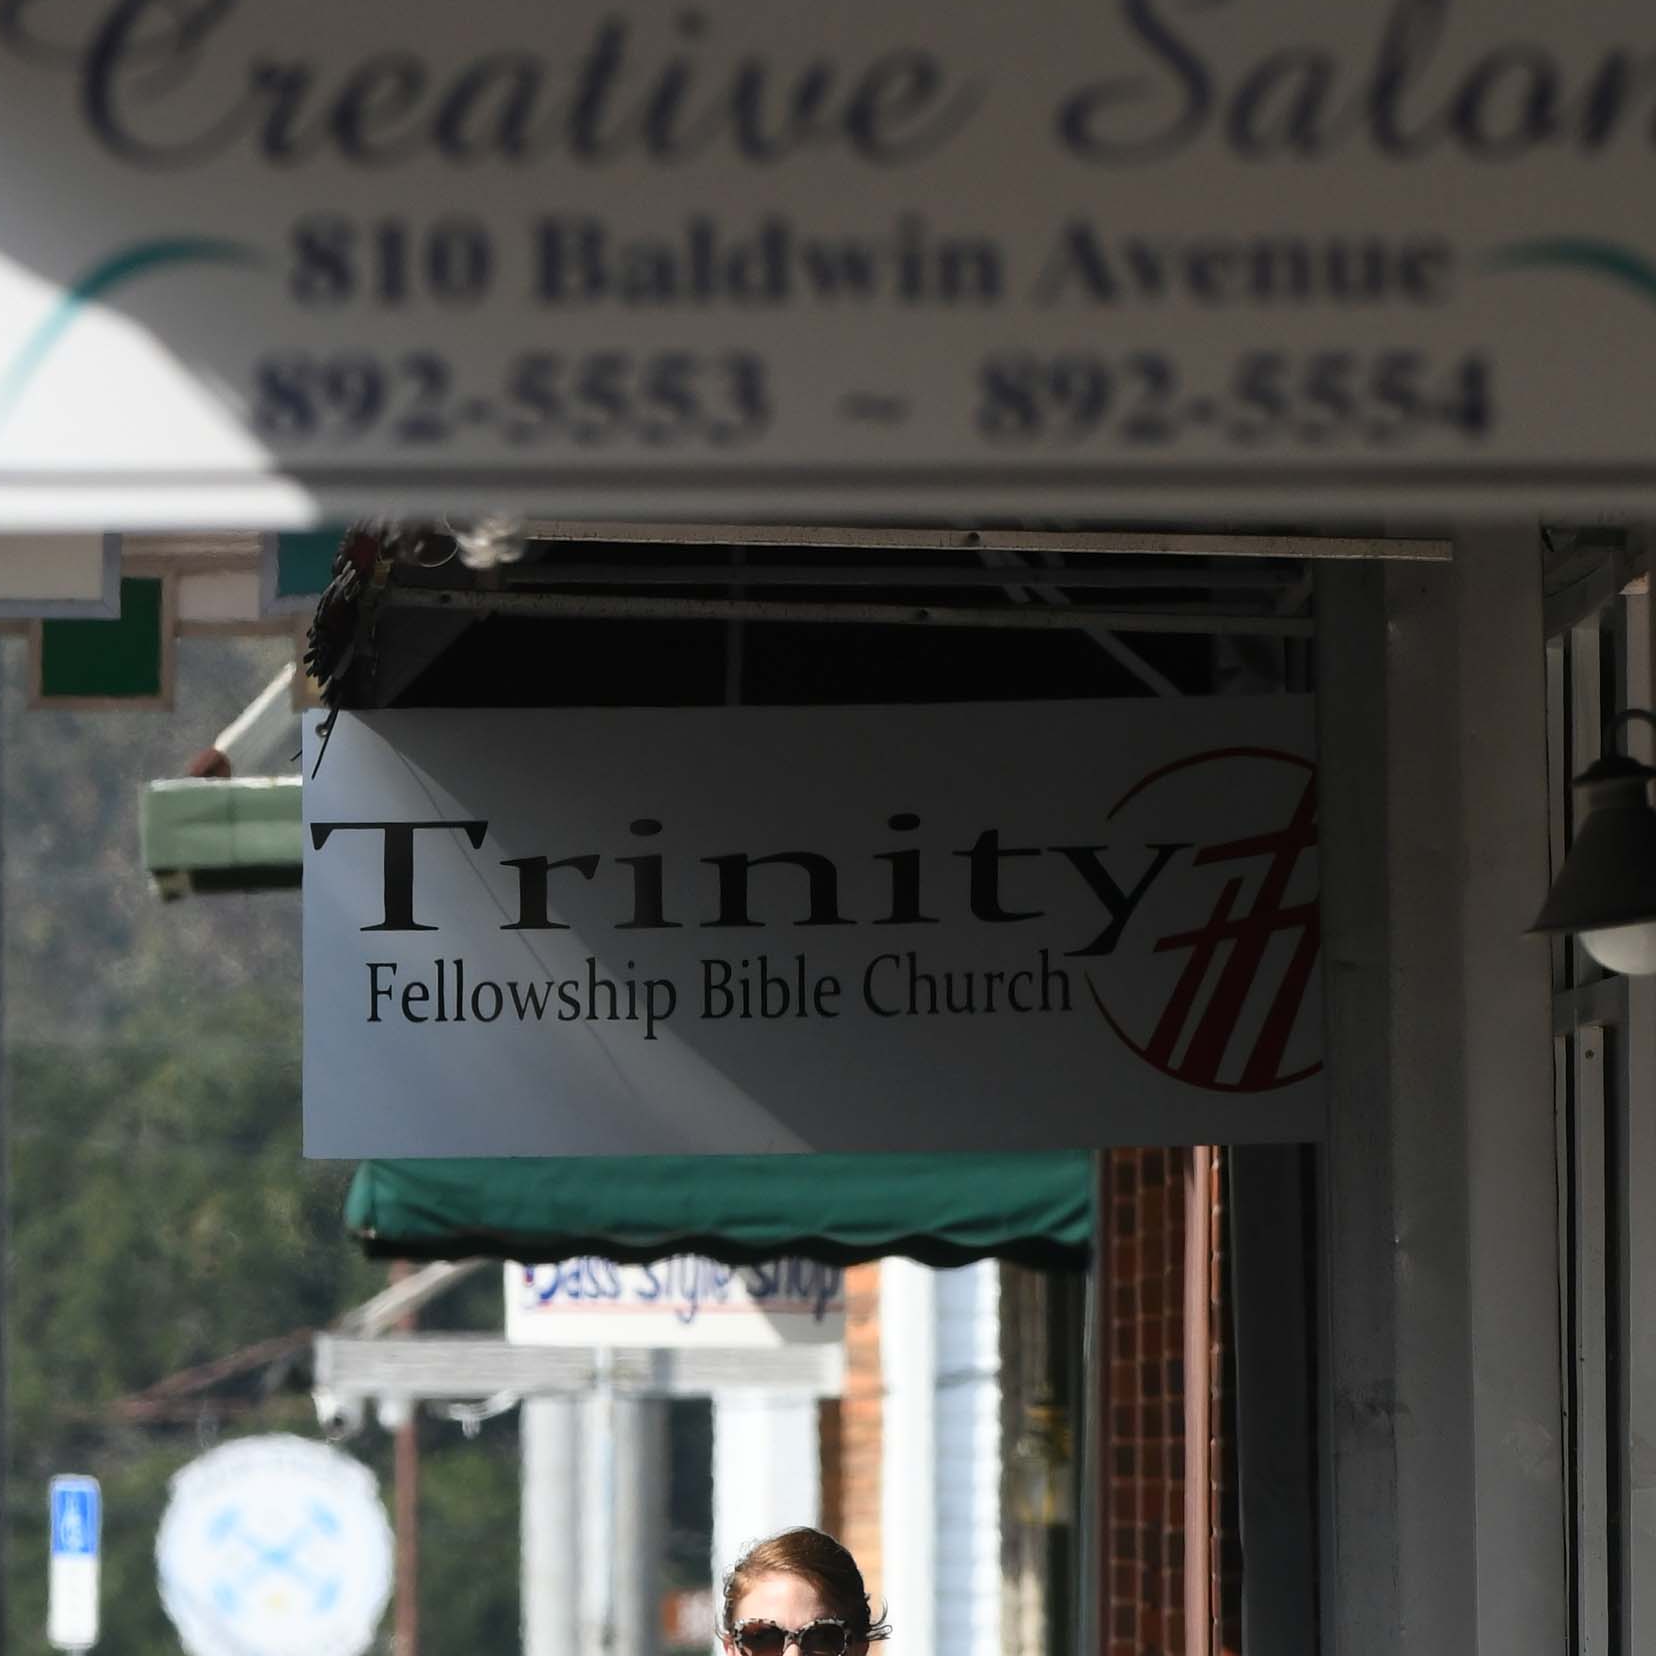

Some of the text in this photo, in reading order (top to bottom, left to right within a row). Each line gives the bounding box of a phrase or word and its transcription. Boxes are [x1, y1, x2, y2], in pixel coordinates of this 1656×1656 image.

[288, 211, 1452, 308] 810 Baldwin Avenue
[249, 352, 770, 445] 892-5553
[976, 352, 1494, 445] 892-5554
[309, 811, 1196, 957] Trinity
[364, 948, 1073, 1041] Fellowship Bible Church
